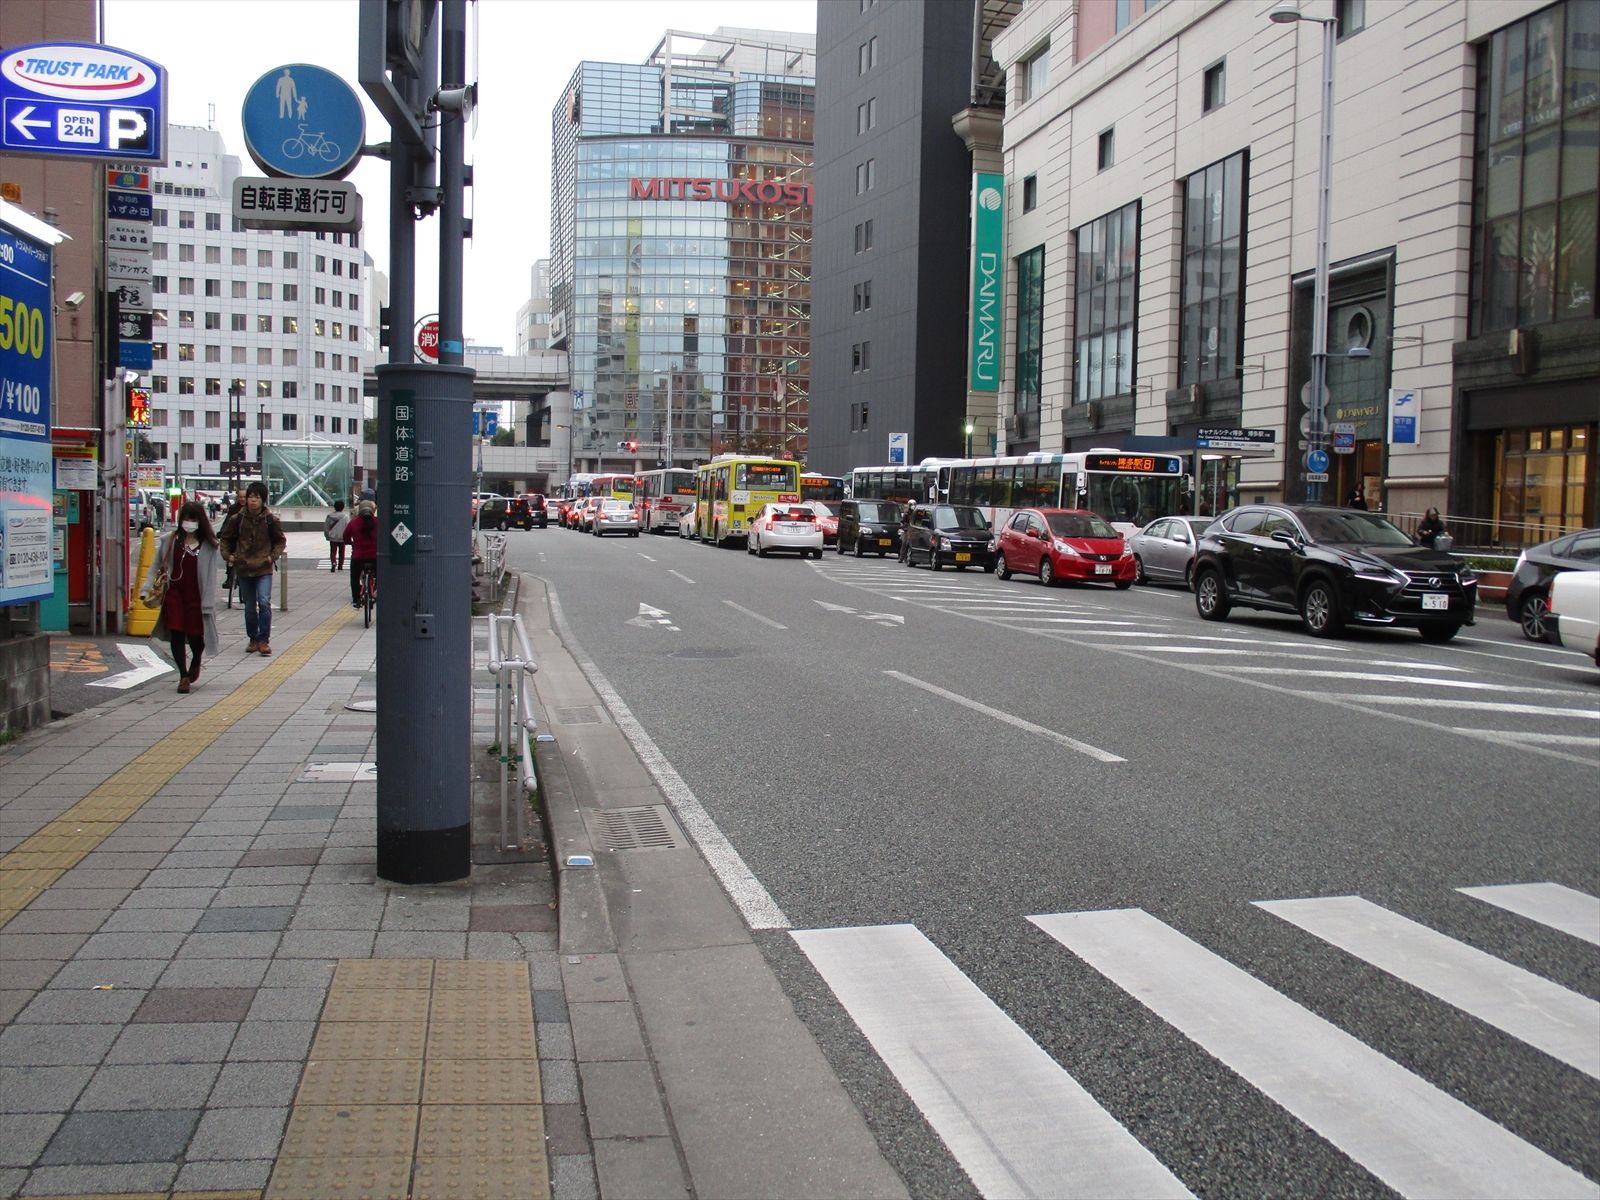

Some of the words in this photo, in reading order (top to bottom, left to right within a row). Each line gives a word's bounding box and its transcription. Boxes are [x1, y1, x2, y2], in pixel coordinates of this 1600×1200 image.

[26, 58, 83, 77] TRUST
[84, 63, 133, 81] PARK
[64, 115, 94, 125] OPEN
[64, 125, 94, 137] 24h
[108, 109, 147, 150] P
[241, 185, 348, 215] 自転車通行可
[630, 177, 814, 206] MITSUKOS
[0, 295, 44, 359] 500
[977, 252, 997, 380] DAIMARU
[395, 405, 409, 481] 国体道路
